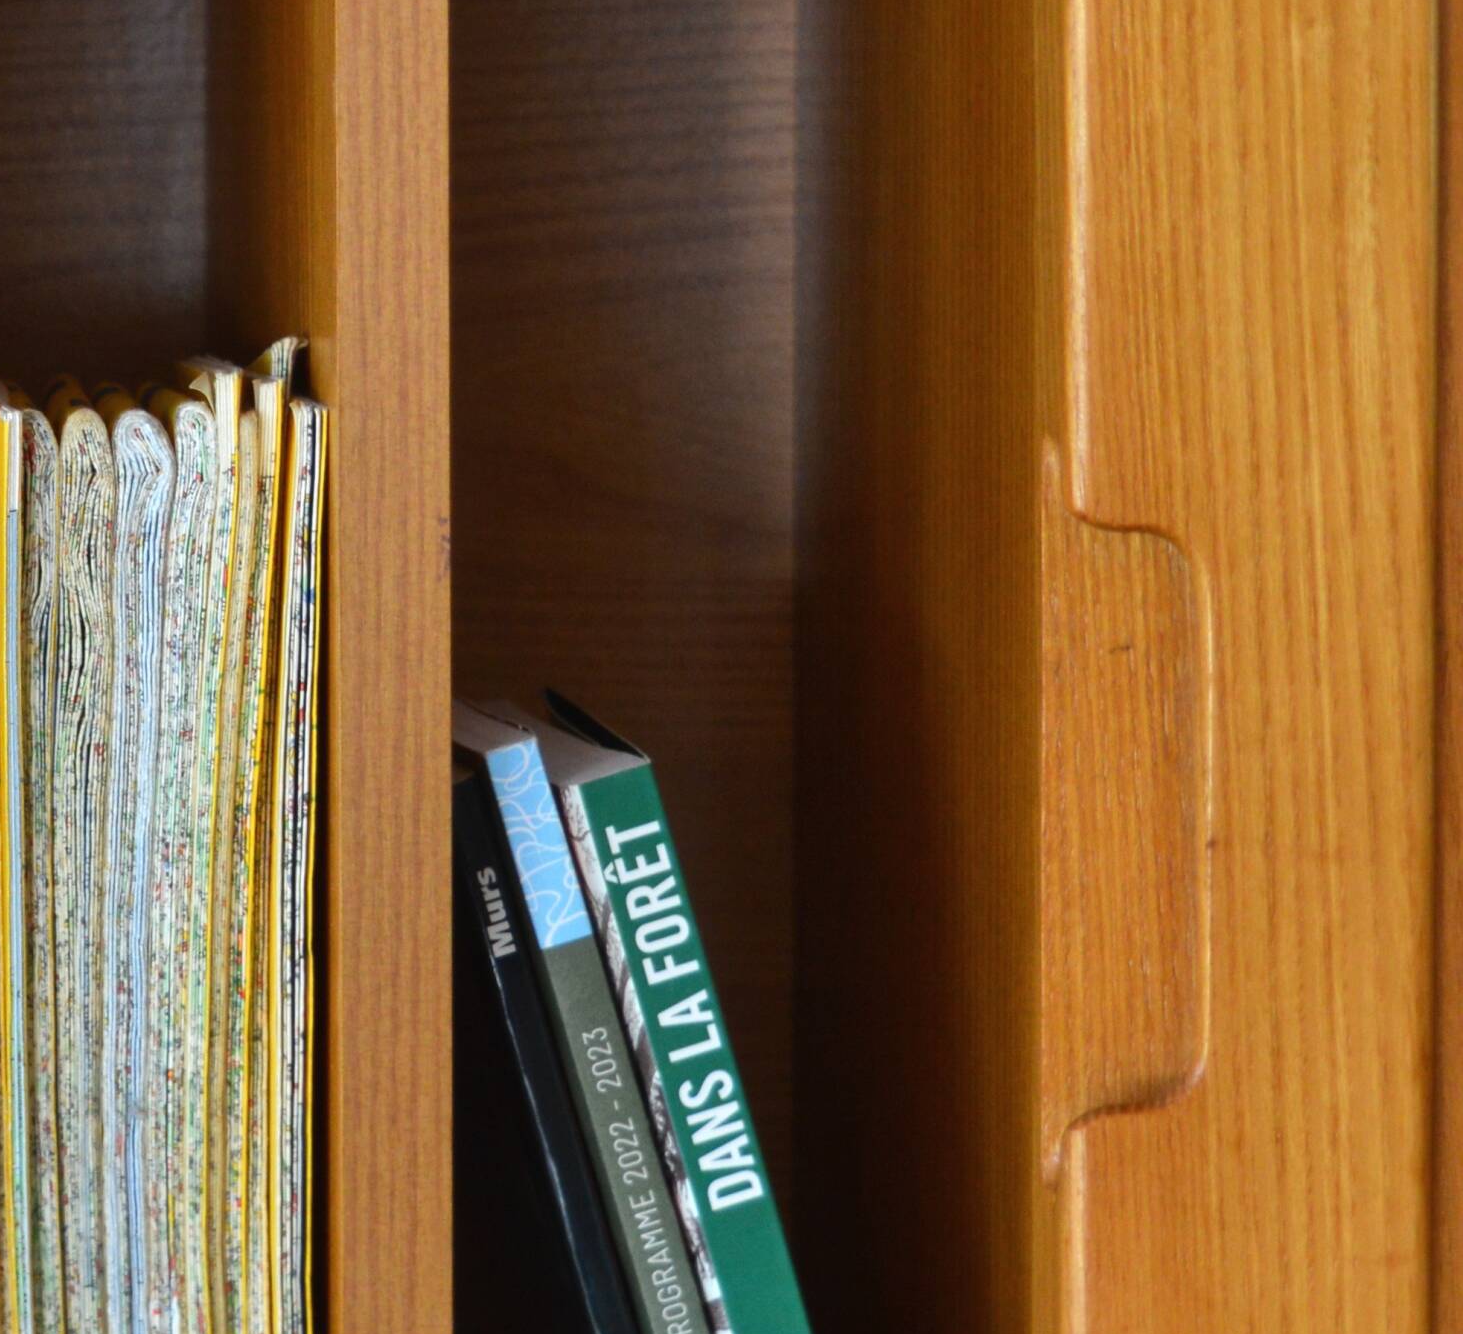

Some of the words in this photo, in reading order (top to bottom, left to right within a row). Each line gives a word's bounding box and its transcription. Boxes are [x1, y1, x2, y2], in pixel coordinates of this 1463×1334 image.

[477, 867, 517, 959] Murs
[604, 820, 700, 986] FORÊT
[582, 1025, 618, 1093] 2023
[657, 989, 722, 1063] LA
[609, 1118, 648, 1191] 2022
[679, 1068, 763, 1212] DANS
